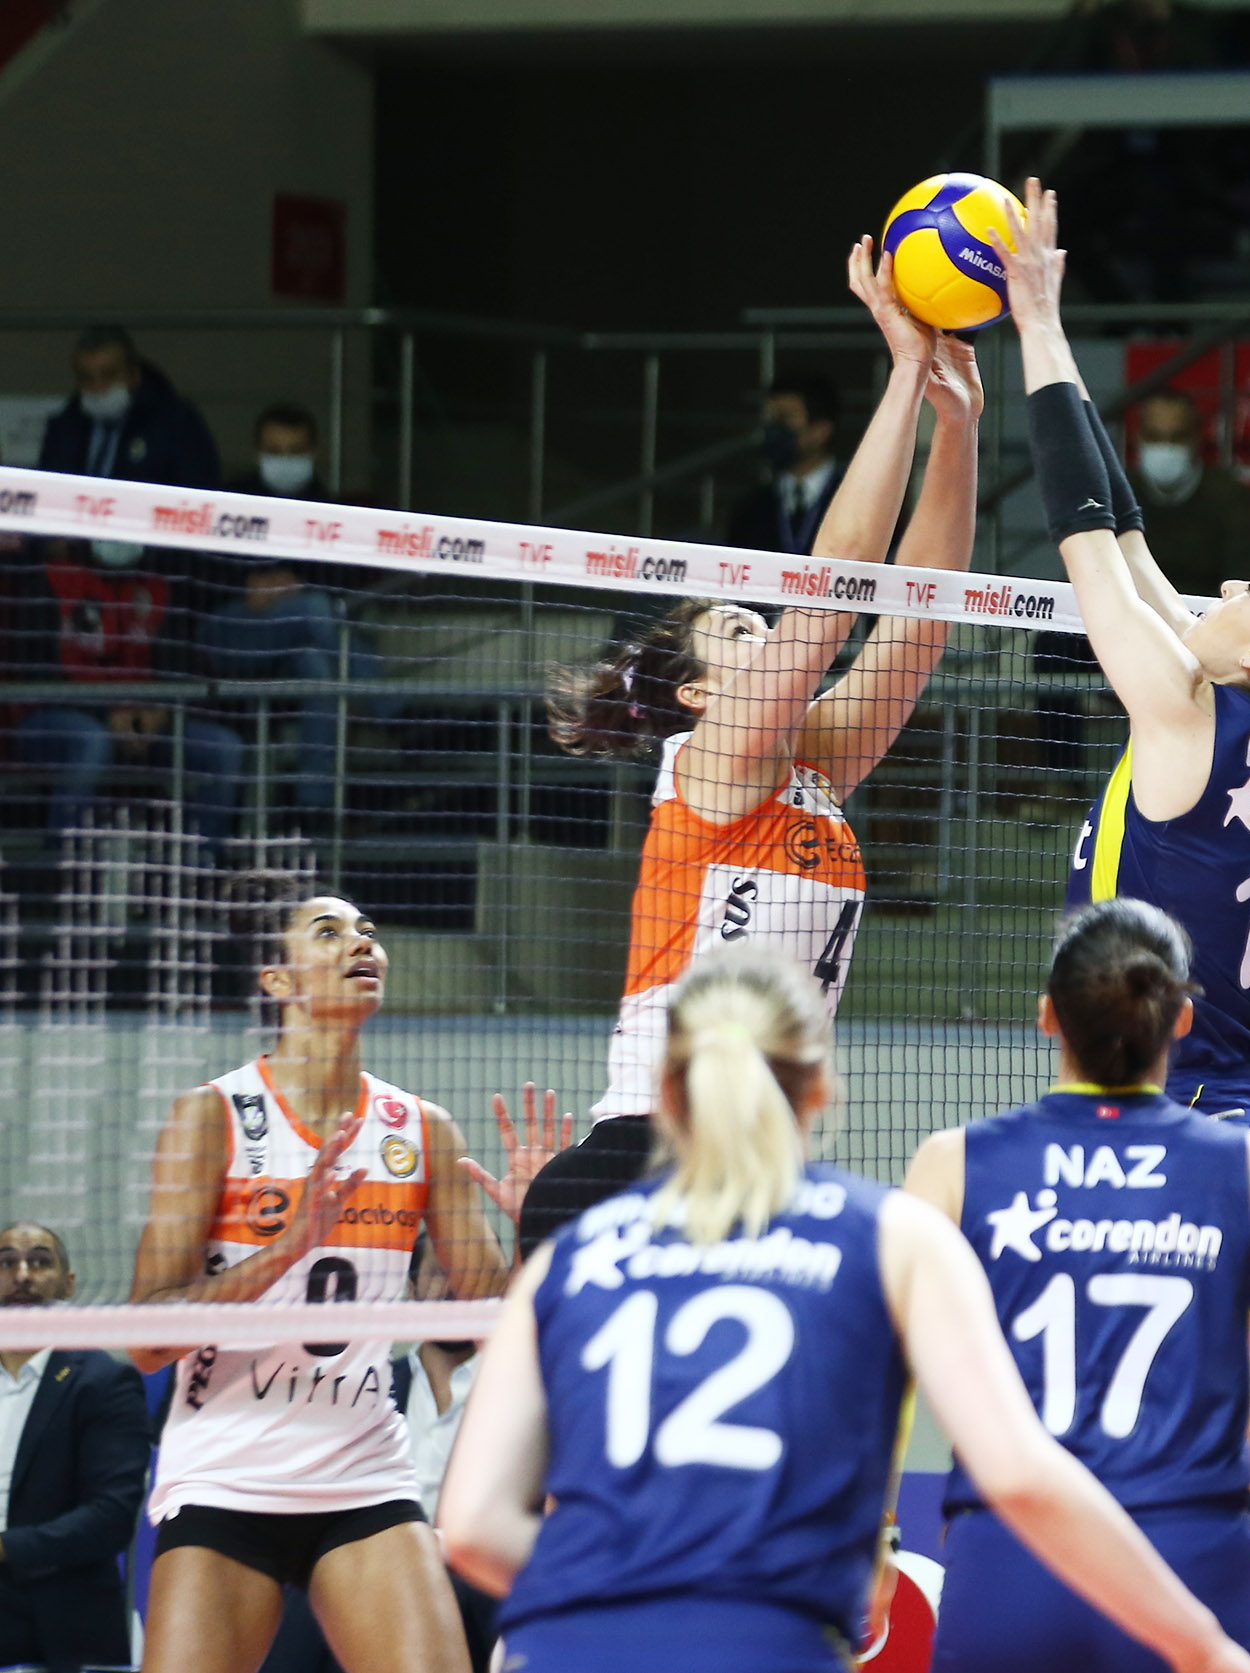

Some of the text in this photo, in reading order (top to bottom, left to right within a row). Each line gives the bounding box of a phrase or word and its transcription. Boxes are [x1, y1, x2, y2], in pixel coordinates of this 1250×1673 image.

[76, 495, 117, 519] TVF
[153, 502, 270, 541] misli.com
[306, 520, 343, 547] TVF
[377, 525, 485, 563] misli.com
[519, 542, 553, 570] TVF
[586, 545, 687, 582] misli.com
[719, 562, 751, 588] TVF
[781, 565, 877, 602] misli.com
[906, 582, 937, 608] TVF
[964, 584, 1055, 620] misli.com
[1044, 1143, 1167, 1188] NAZ
[1047, 1212, 1223, 1258] corendon
[580, 1285, 796, 1471] 12
[1012, 1272, 1194, 1438] 17
